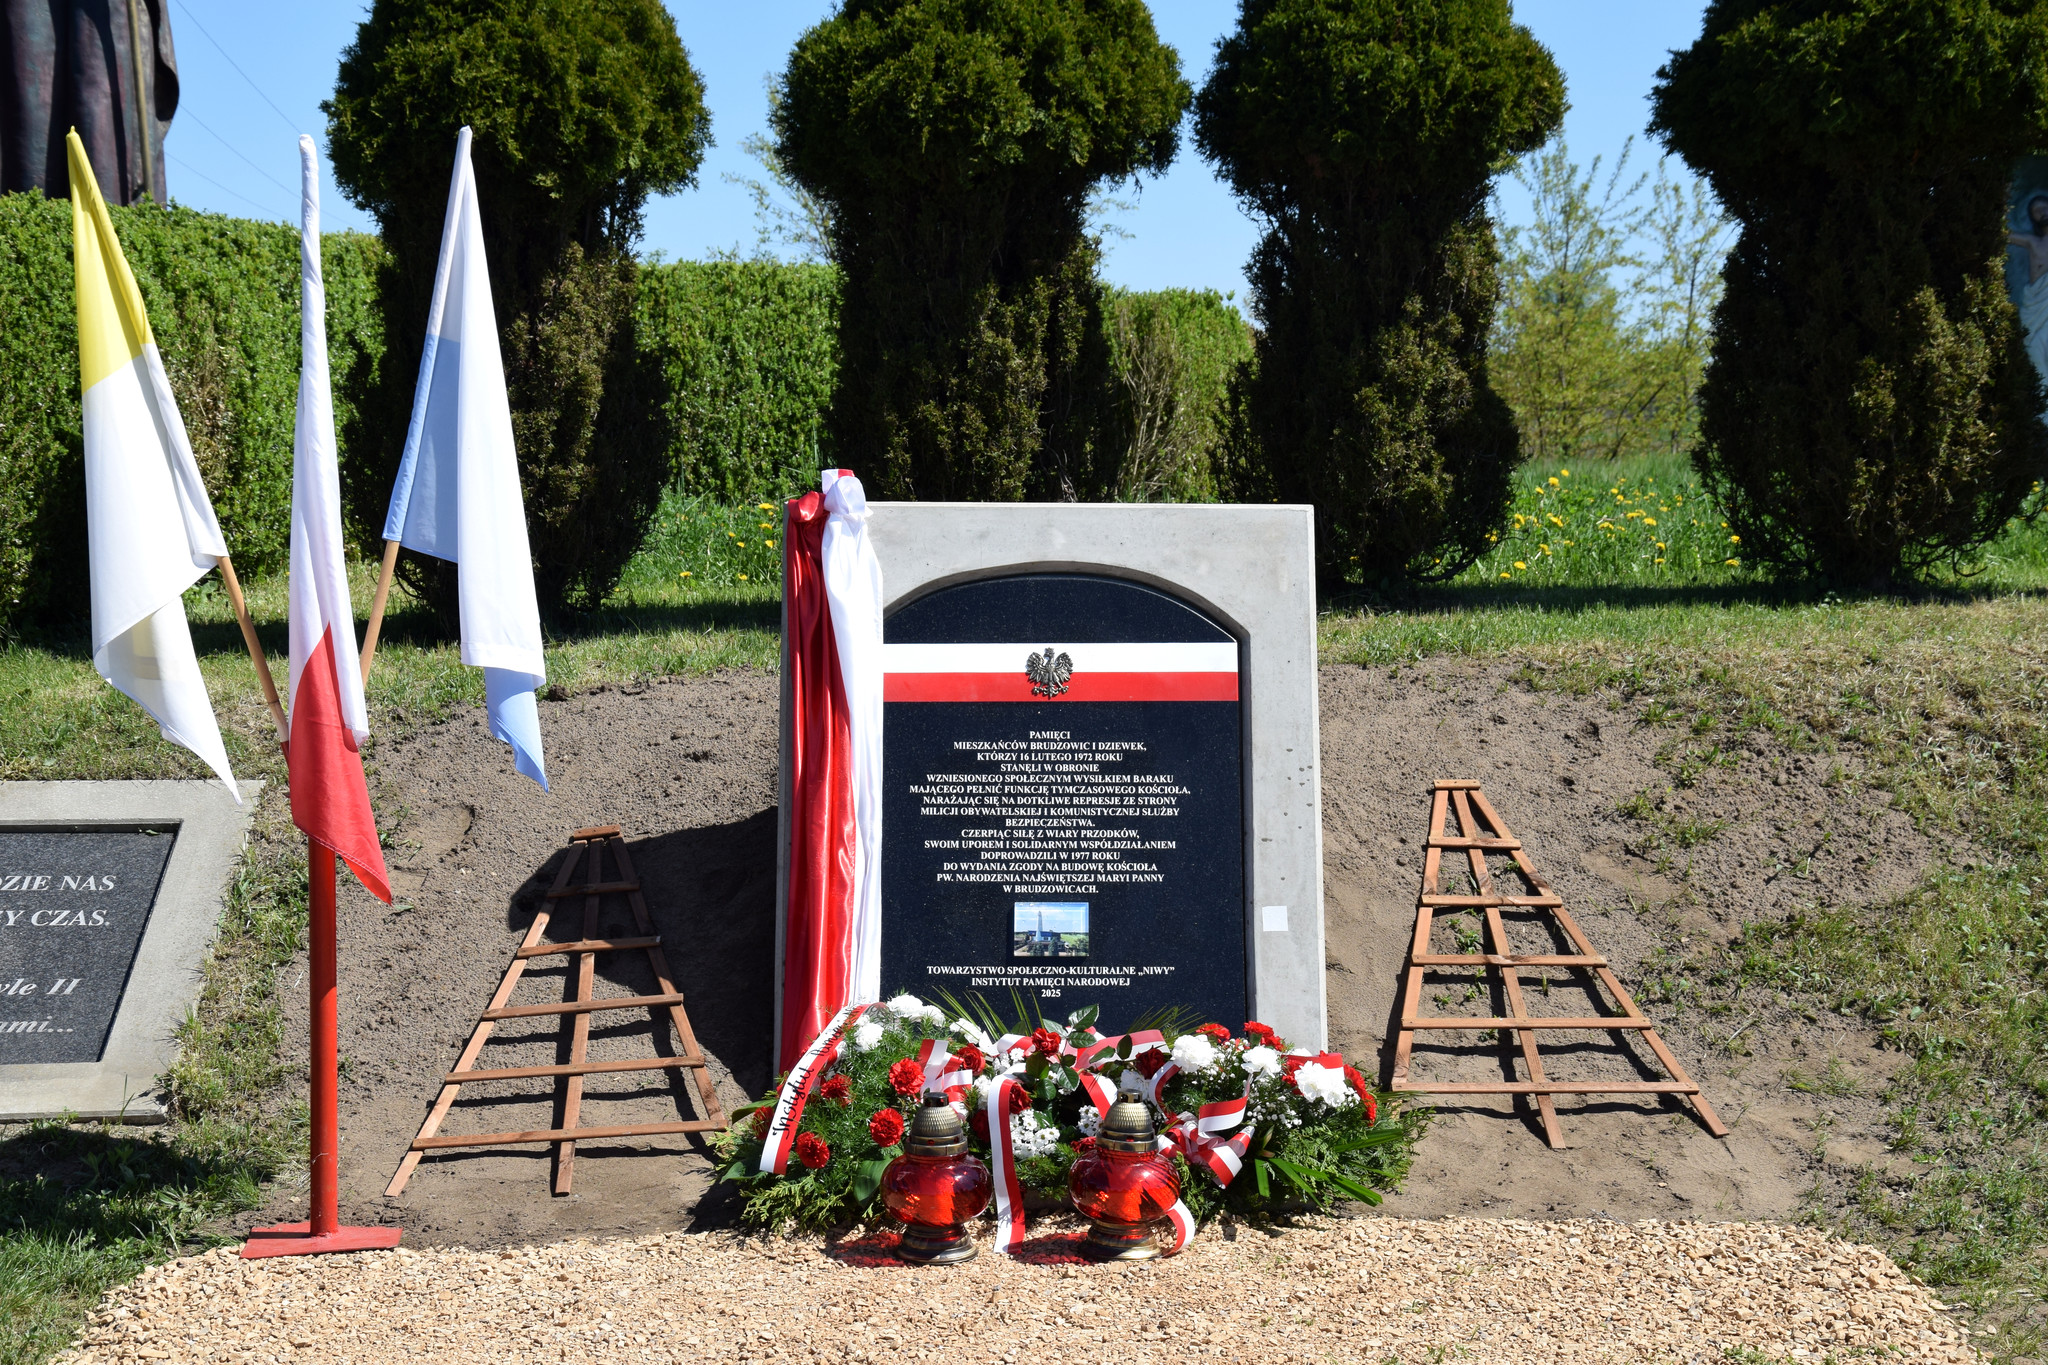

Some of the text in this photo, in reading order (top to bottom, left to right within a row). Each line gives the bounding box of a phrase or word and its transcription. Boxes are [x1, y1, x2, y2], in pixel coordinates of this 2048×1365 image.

[1029, 730, 1071, 741] PAMIĘCI
[953, 739, 1029, 750] MIESZKAŃCÓW
[1030, 741, 1091, 751] BRUDZOWIC
[1098, 741, 1147, 752] DZIEWEK,
[976, 750, 1123, 762] KTÓRZY 16 LUTEGO 1972 ROKU
[1000, 763, 1100, 774] STANĘLI W OBRONIE
[926, 774, 1174, 784] WZNIESIONEGO SPOŁECZNYM WYSIŁKIEM BARAKU
[909, 783, 1191, 796] MAJĄCEGO PEŁNIĆ FUNKCJĘ TYMCZASOWEGO KOŚCIOŁA,
[923, 794, 1178, 807] NARAŻAJĄC SIĘ NA DOTKLIWE REPRESJE ZE STRONY
[920, 807, 959, 817] MILICJI
[960, 807, 1042, 817] OBYWATELSKIEJ
[1049, 807, 1140, 817] KOMUNISTYCZNEJ
[1141, 805, 1180, 816] SŁUŻBY
[1005, 816, 1096, 827] BEZPIECZEŃSTWA.
[960, 827, 1140, 840] CZERPIĄC SIŁĘ Z WIARY PRZODKÓW,
[924, 840, 960, 850] SWOIM
[961, 840, 1004, 850] UPOREM
[1011, 840, 1078, 850] SOLIDARNYM
[1079, 838, 1177, 849] WSPÓŁDZIAŁANIEM
[980, 851, 1121, 861] DOPROWADZILI W 1977 ROKU
[943, 860, 1158, 873] DO WYDANIA ZGODY NA BUDOWĘ KOŚCIOŁA
[0, 875, 117, 891] ZIE NAS
[936, 871, 1165, 884] PW. NARODZENIA NAJŚWIĘTSZEJ MARYI PANNY
[1002, 884, 1099, 894] W BRUDZOWICACH.
[31, 909, 110, 926] CZAS.
[926, 966, 1006, 976] TOWARZYSTWO
[1006, 966, 1137, 976] SPOŁECZNO-KULTURALNE
[46, 978, 81, 995] II
[971, 977, 1131, 988] INSTYTUT PAMIĘCI NARODOWEJ
[1041, 989, 1062, 999] 2025
